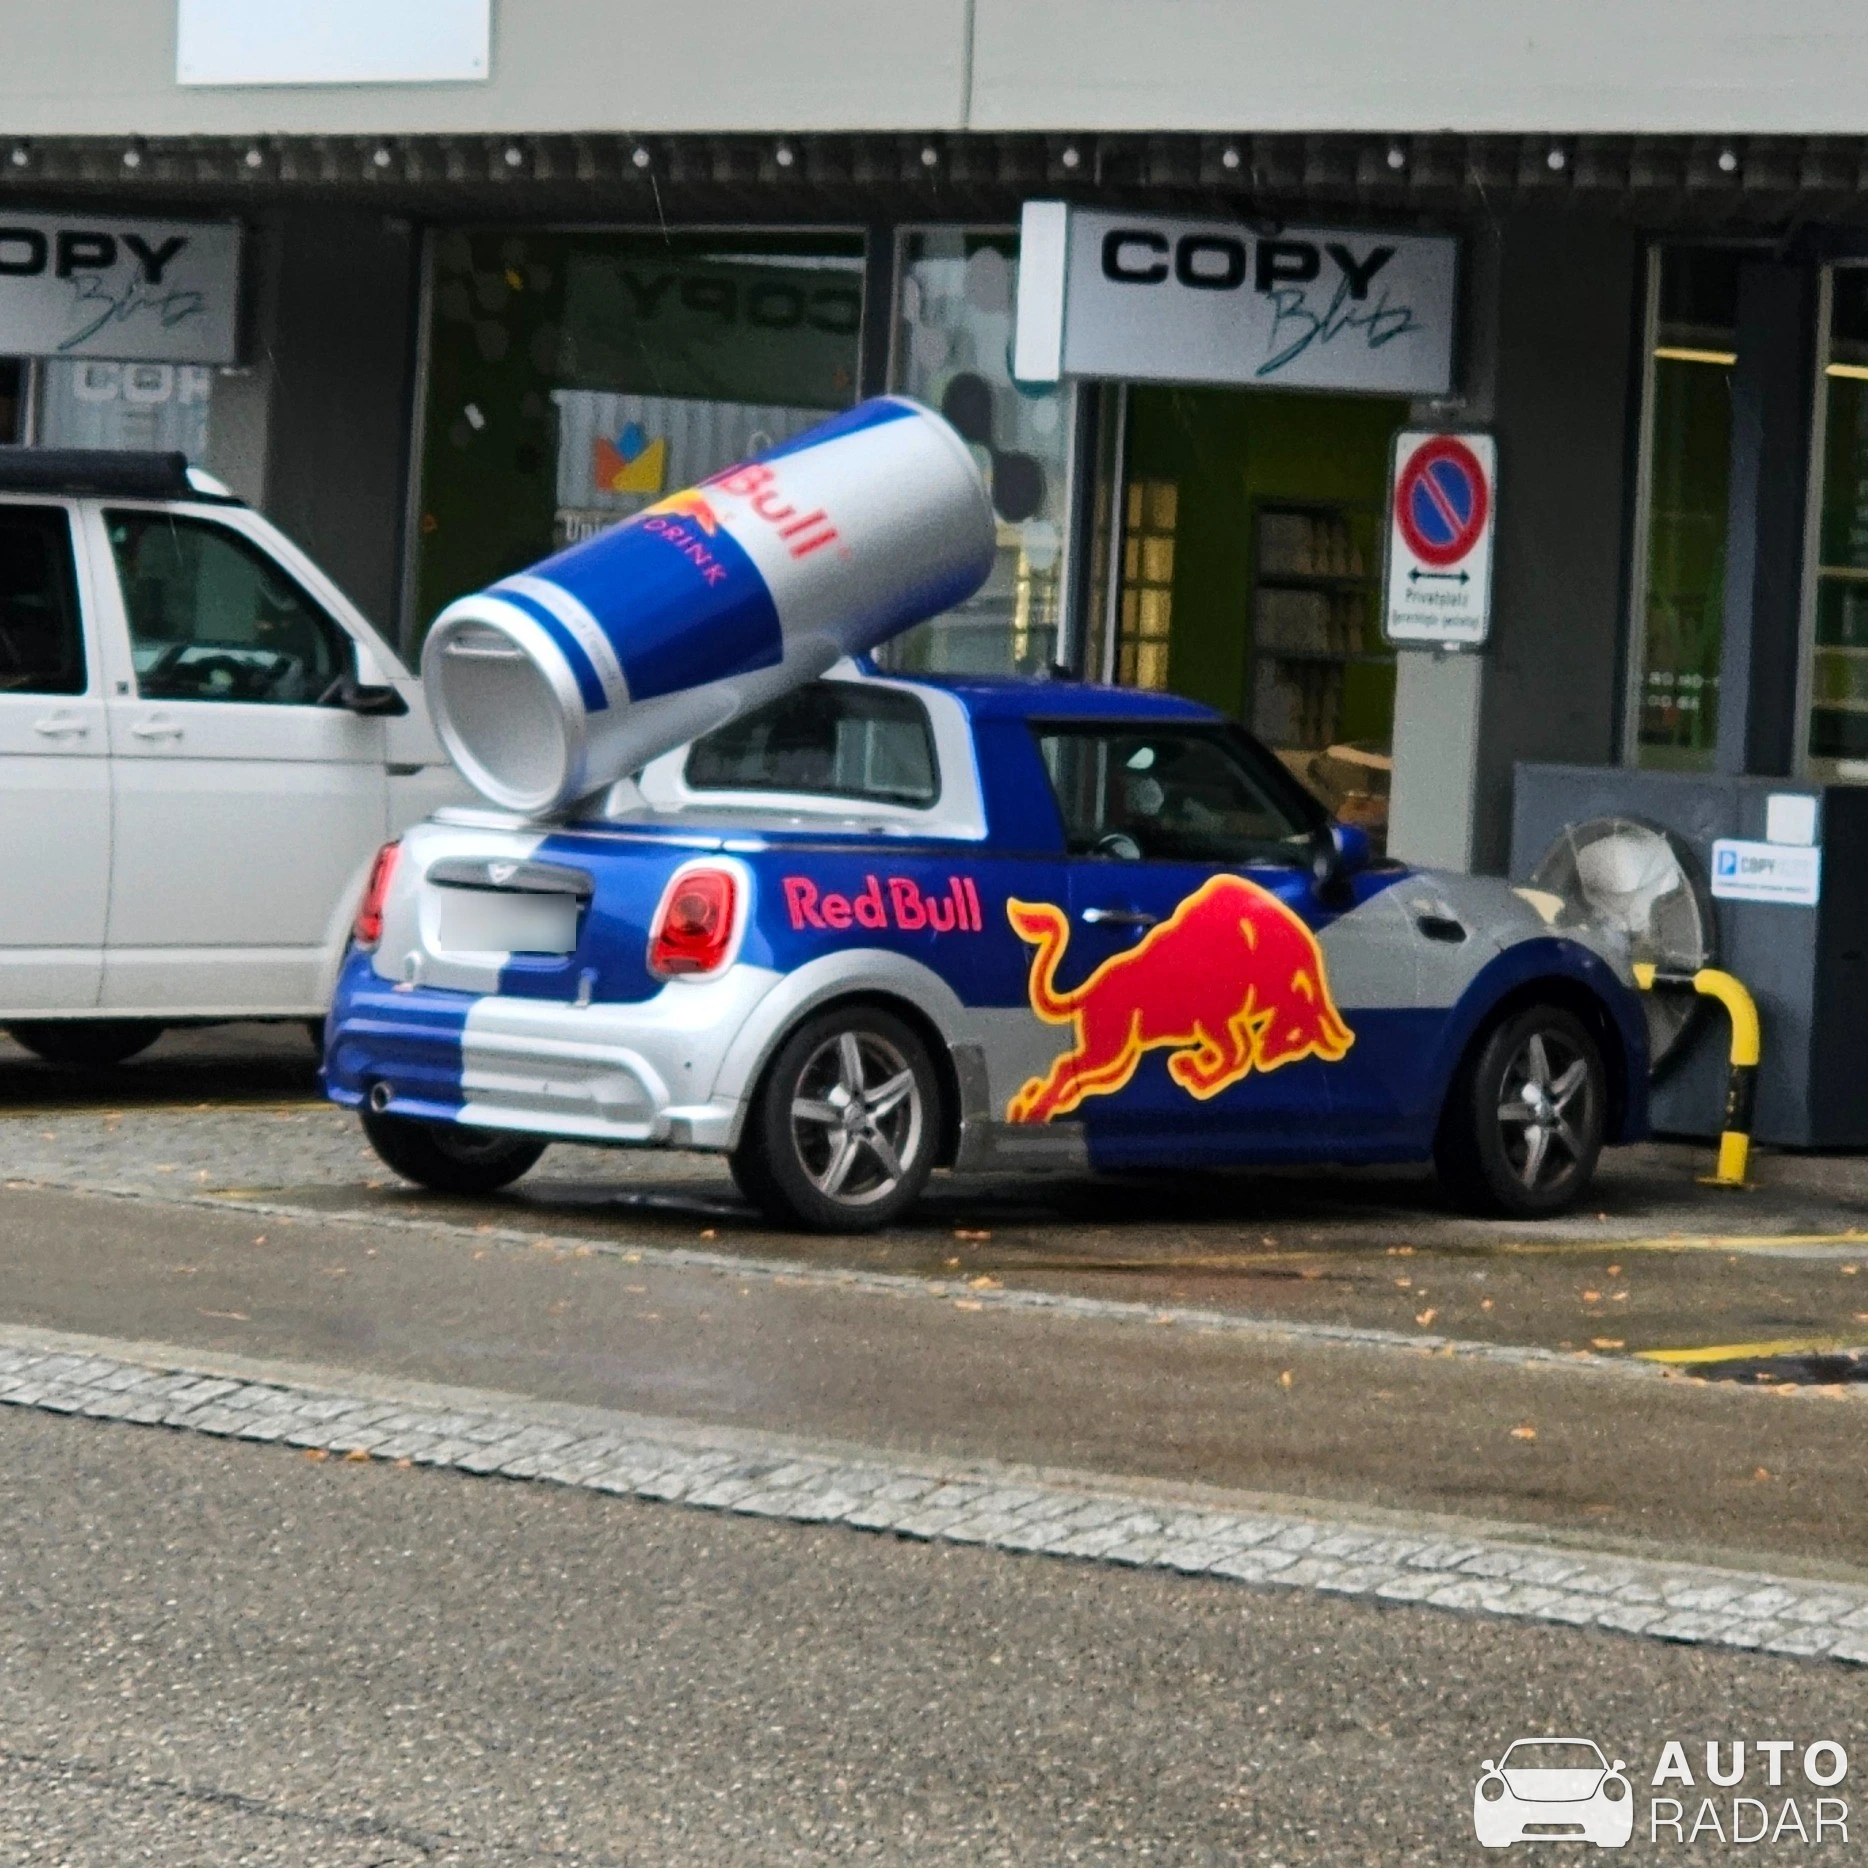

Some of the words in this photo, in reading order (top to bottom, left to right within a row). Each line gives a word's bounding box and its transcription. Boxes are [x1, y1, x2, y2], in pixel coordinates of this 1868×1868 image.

[1101, 229, 1398, 299] COPY
[1254, 270, 1424, 378] Blitz
[783, 874, 888, 930] Red
[888, 876, 983, 931] Bull
